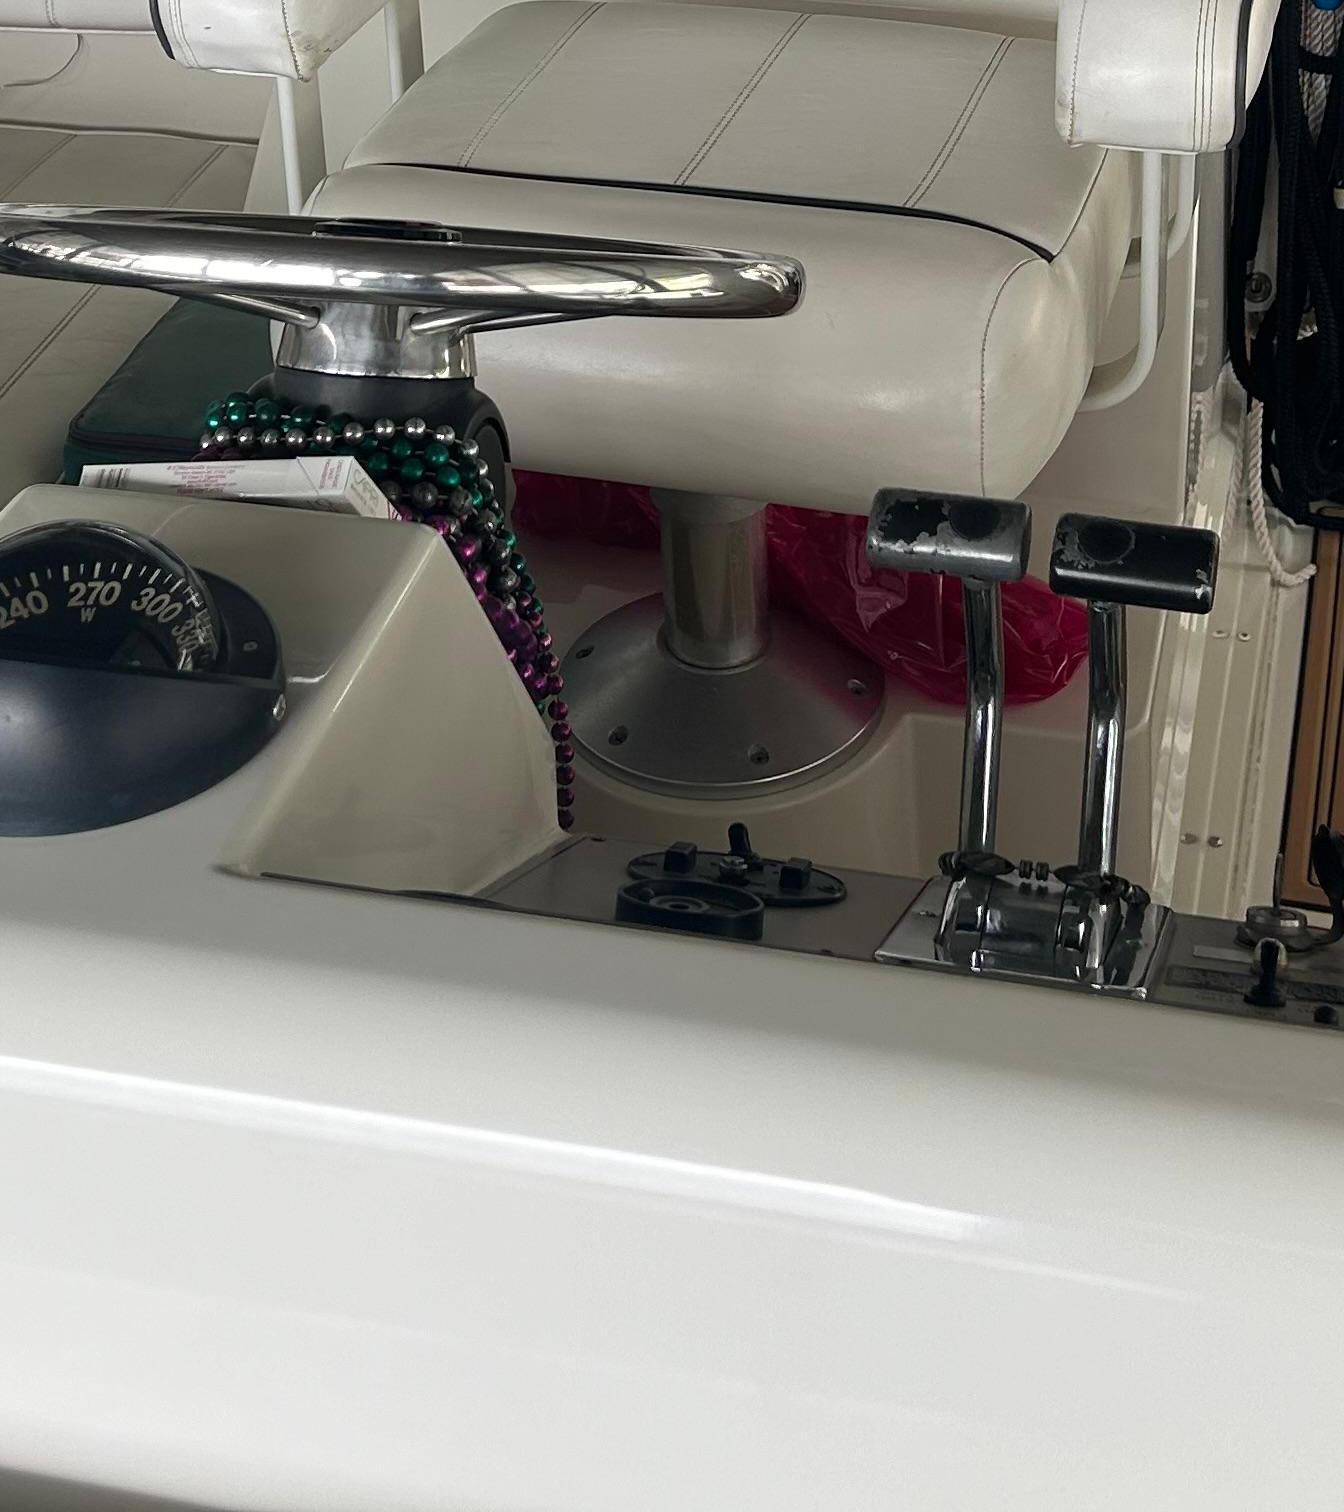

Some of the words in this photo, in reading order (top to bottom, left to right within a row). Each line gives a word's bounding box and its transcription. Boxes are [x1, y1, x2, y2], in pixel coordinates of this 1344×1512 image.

[67, 580, 122, 608] 270
[131, 587, 184, 624] 300
[80, 607, 97, 624] W
